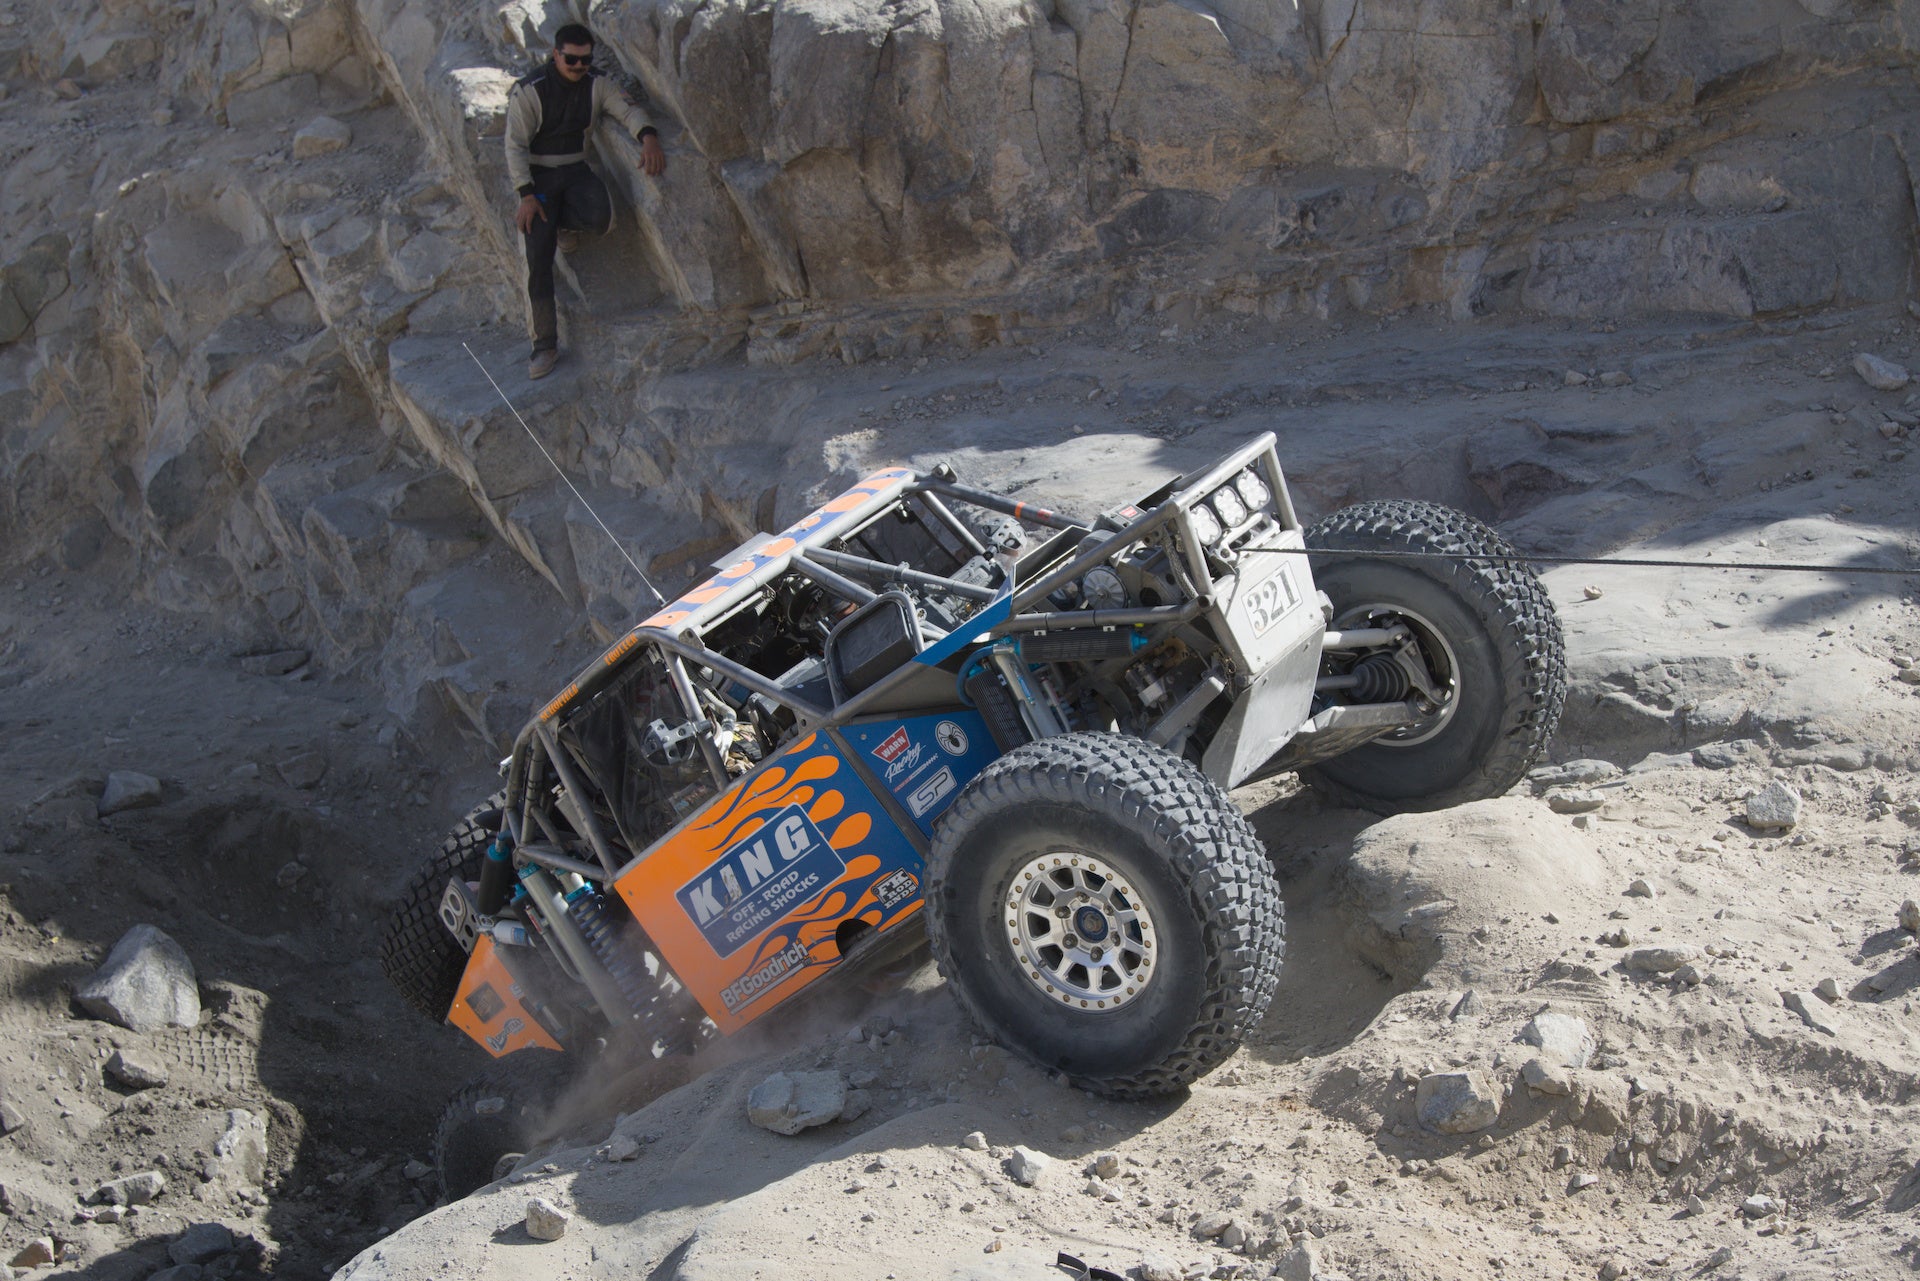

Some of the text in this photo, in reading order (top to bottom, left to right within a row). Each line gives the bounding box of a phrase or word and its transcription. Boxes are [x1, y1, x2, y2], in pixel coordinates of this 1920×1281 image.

[1247, 568, 1300, 632] 321
[880, 734, 907, 759] WARN
[884, 742, 926, 784] Racing
[916, 771, 948, 812] SP
[689, 814, 811, 925] KING
[886, 879, 913, 900] ROD
[725, 871, 820, 943] RACING SHOCKS
[731, 903, 756, 923] OFF
[762, 869, 800, 900] ROAD
[884, 885, 917, 910] ENDS
[720, 941, 809, 1009] BFGoodrich
